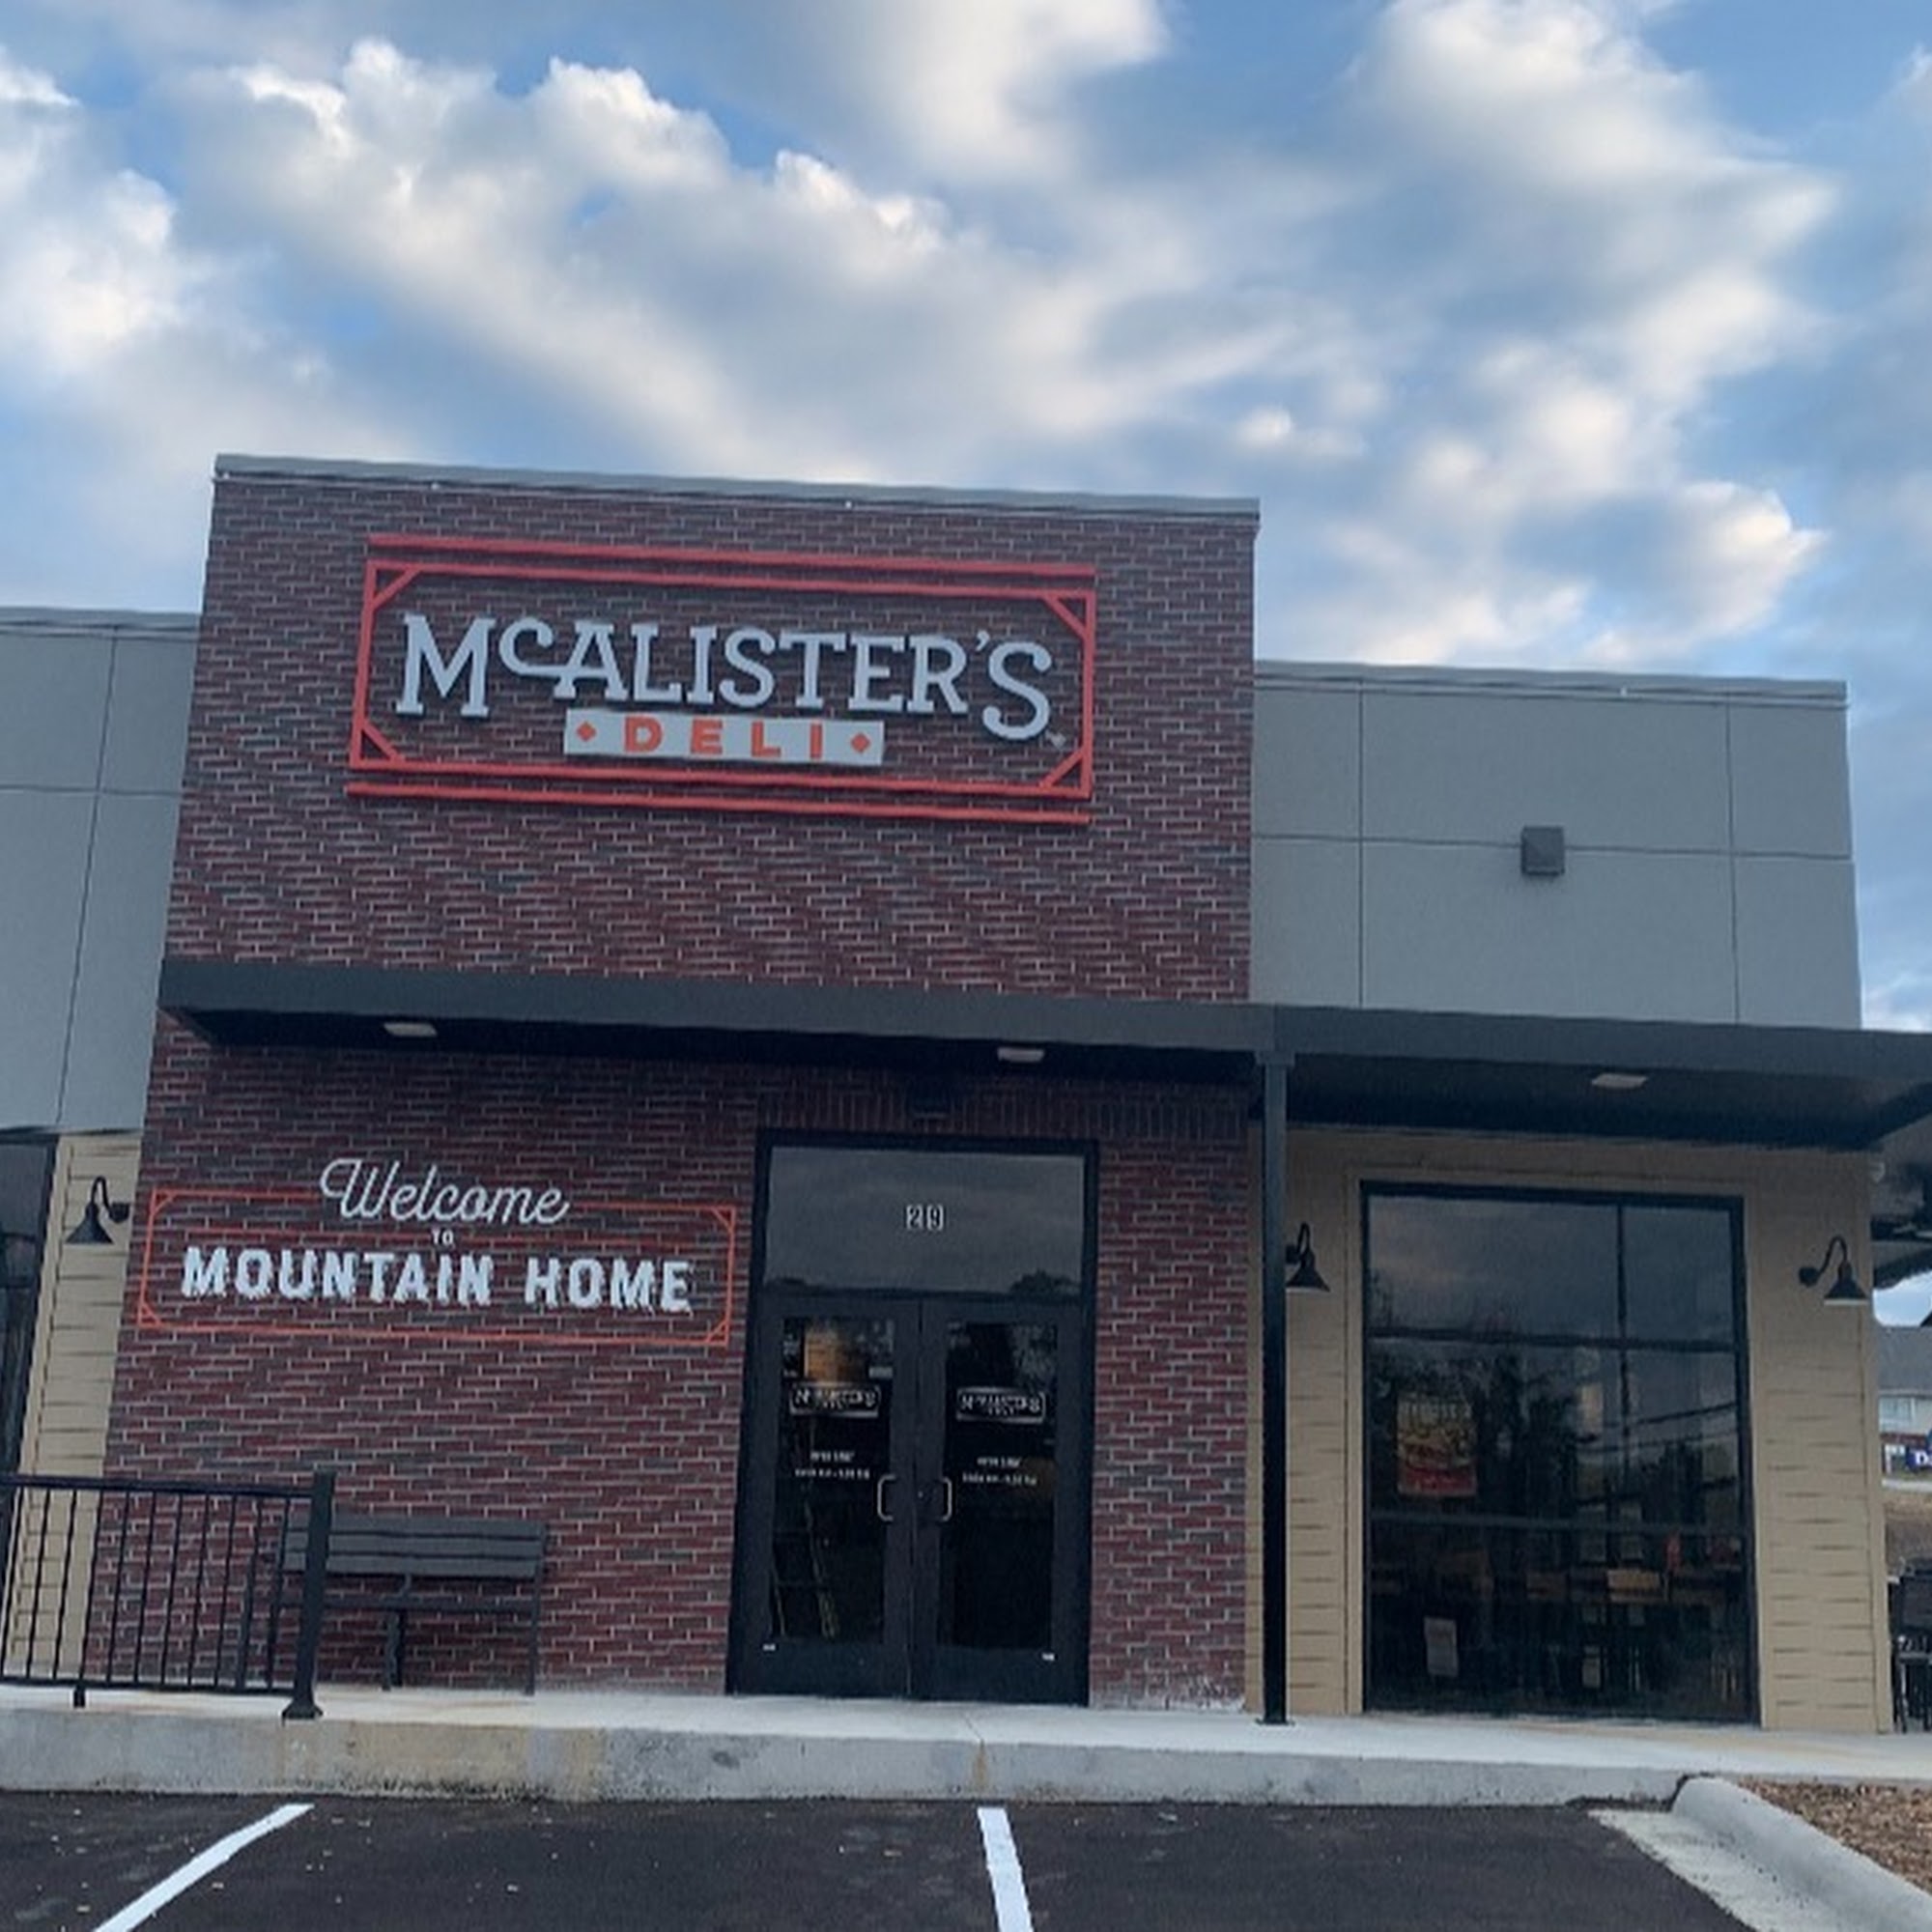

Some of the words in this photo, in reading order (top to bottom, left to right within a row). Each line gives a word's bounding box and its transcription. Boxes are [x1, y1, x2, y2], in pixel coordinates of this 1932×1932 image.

[622, 715, 824, 759] DELI
[319, 1157, 571, 1226] Welcome
[432, 1228, 454, 1246] TO
[181, 1246, 492, 1307] MOUNTAIN
[525, 1256, 694, 1314] HOME
